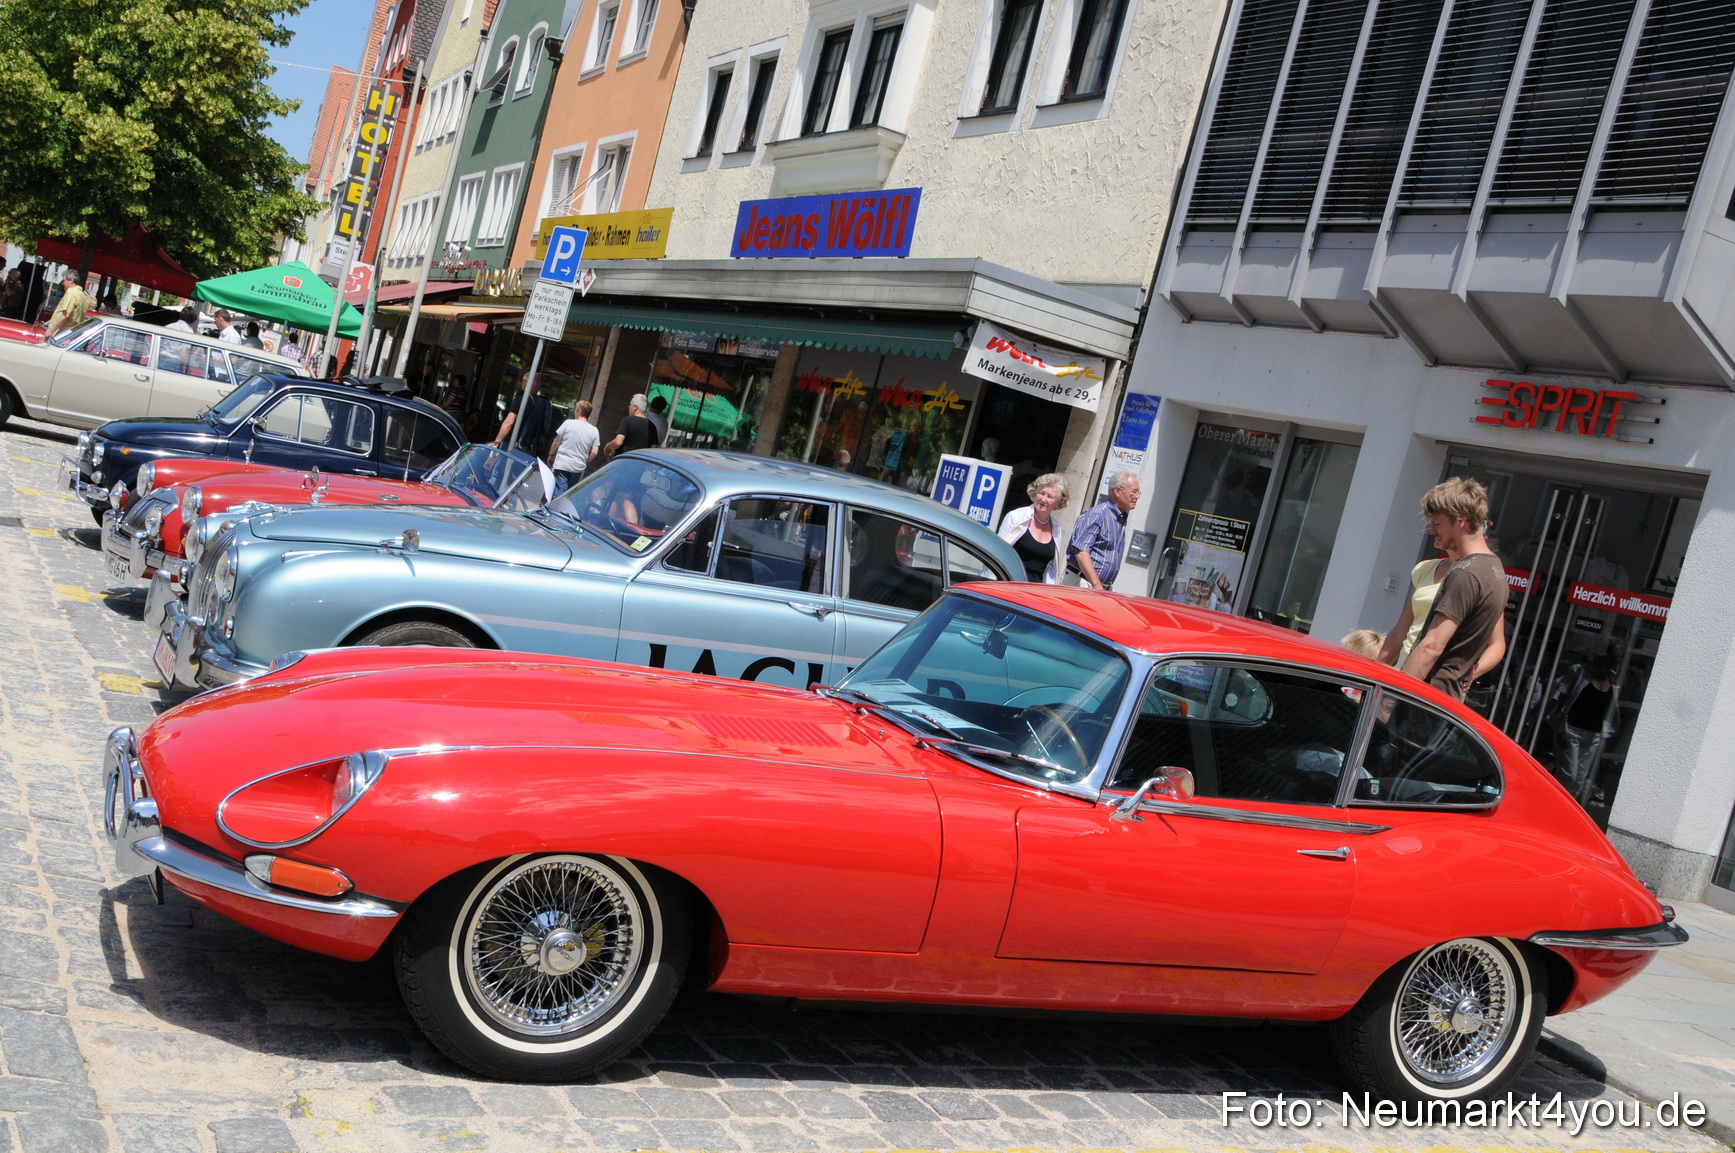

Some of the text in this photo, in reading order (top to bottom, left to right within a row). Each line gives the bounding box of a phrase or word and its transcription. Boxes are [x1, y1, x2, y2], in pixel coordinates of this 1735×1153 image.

[339, 89, 395, 237] HOTEL
[739, 194, 912, 250] Jeans Wölfl
[605, 225, 631, 246] Rahmen
[549, 234, 576, 273] P
[251, 285, 327, 309] Lammsbräu
[263, 283, 318, 301] Neumarkter
[534, 293, 567, 307] Parkschein
[534, 303, 562, 315] werktags
[525, 321, 532, 329] Sa
[674, 338, 708, 349] Foto Studio
[977, 358, 1048, 390] Markenjeans
[1049, 384, 1063, 395] ab
[1065, 387, 1073, 396] €
[1475, 379, 1637, 438] ESPRIT
[1198, 425, 1275, 449] Oberer Markt
[1112, 449, 1142, 462] NATHUS
[942, 465, 966, 482] HIER
[977, 474, 995, 500] P
[1573, 586, 1670, 617] Herzlich willkomm
[1576, 619, 1601, 629] DRÜCKEN
